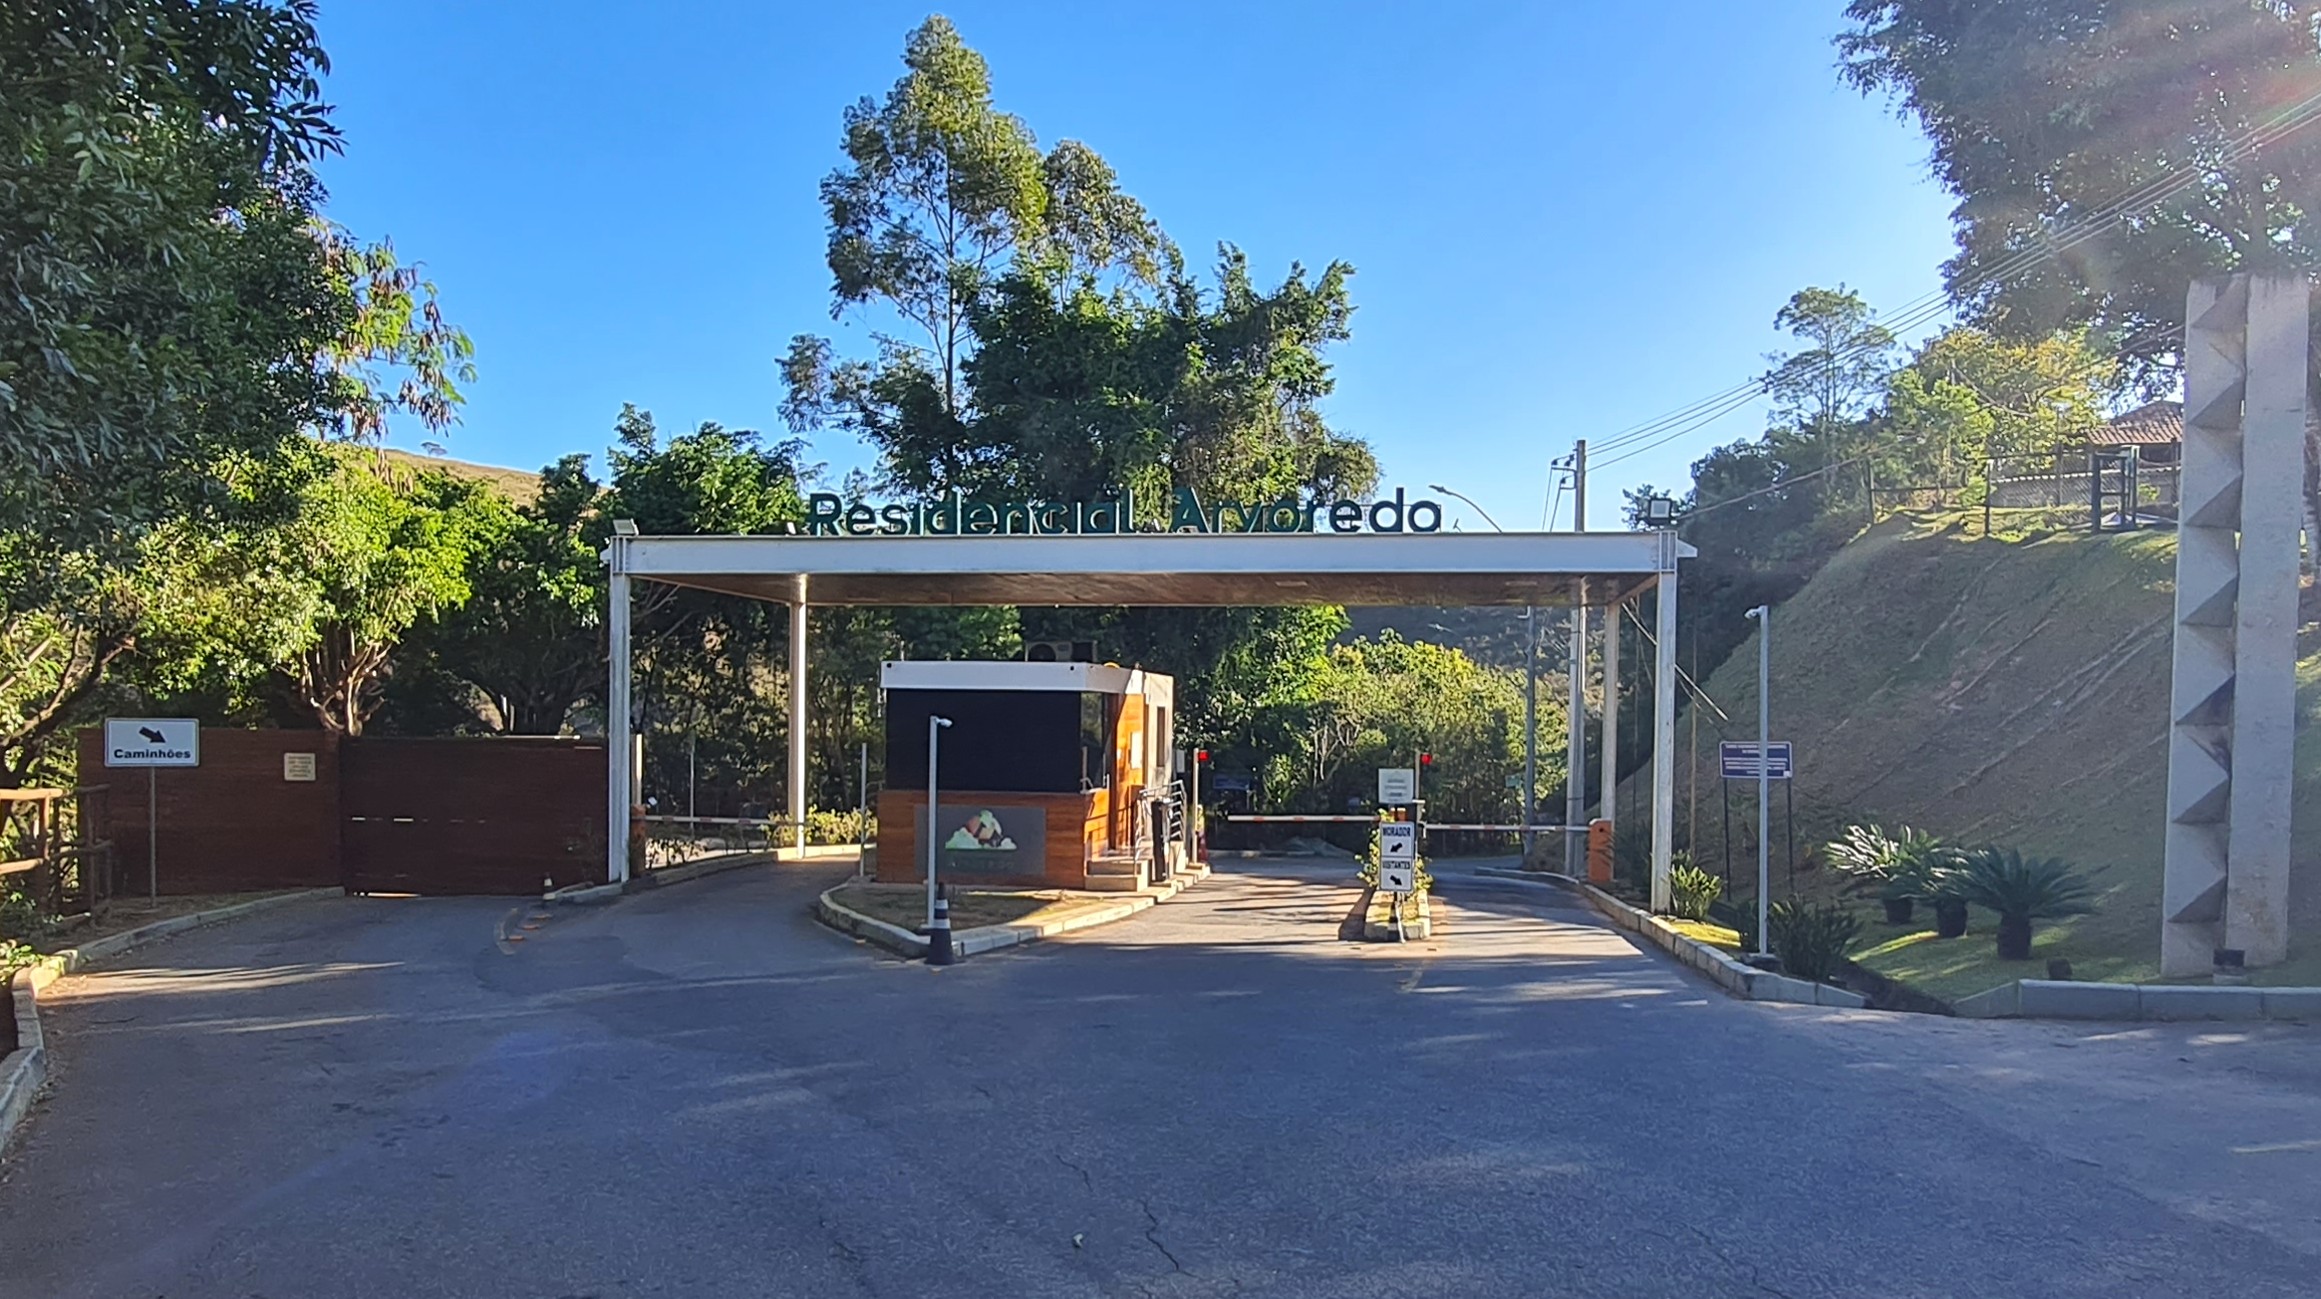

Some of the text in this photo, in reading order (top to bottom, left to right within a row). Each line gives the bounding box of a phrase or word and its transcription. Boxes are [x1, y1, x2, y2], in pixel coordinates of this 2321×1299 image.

[809, 487, 1442, 535] Residencial Arvoredo
[113, 749, 191, 759] Caminhões
